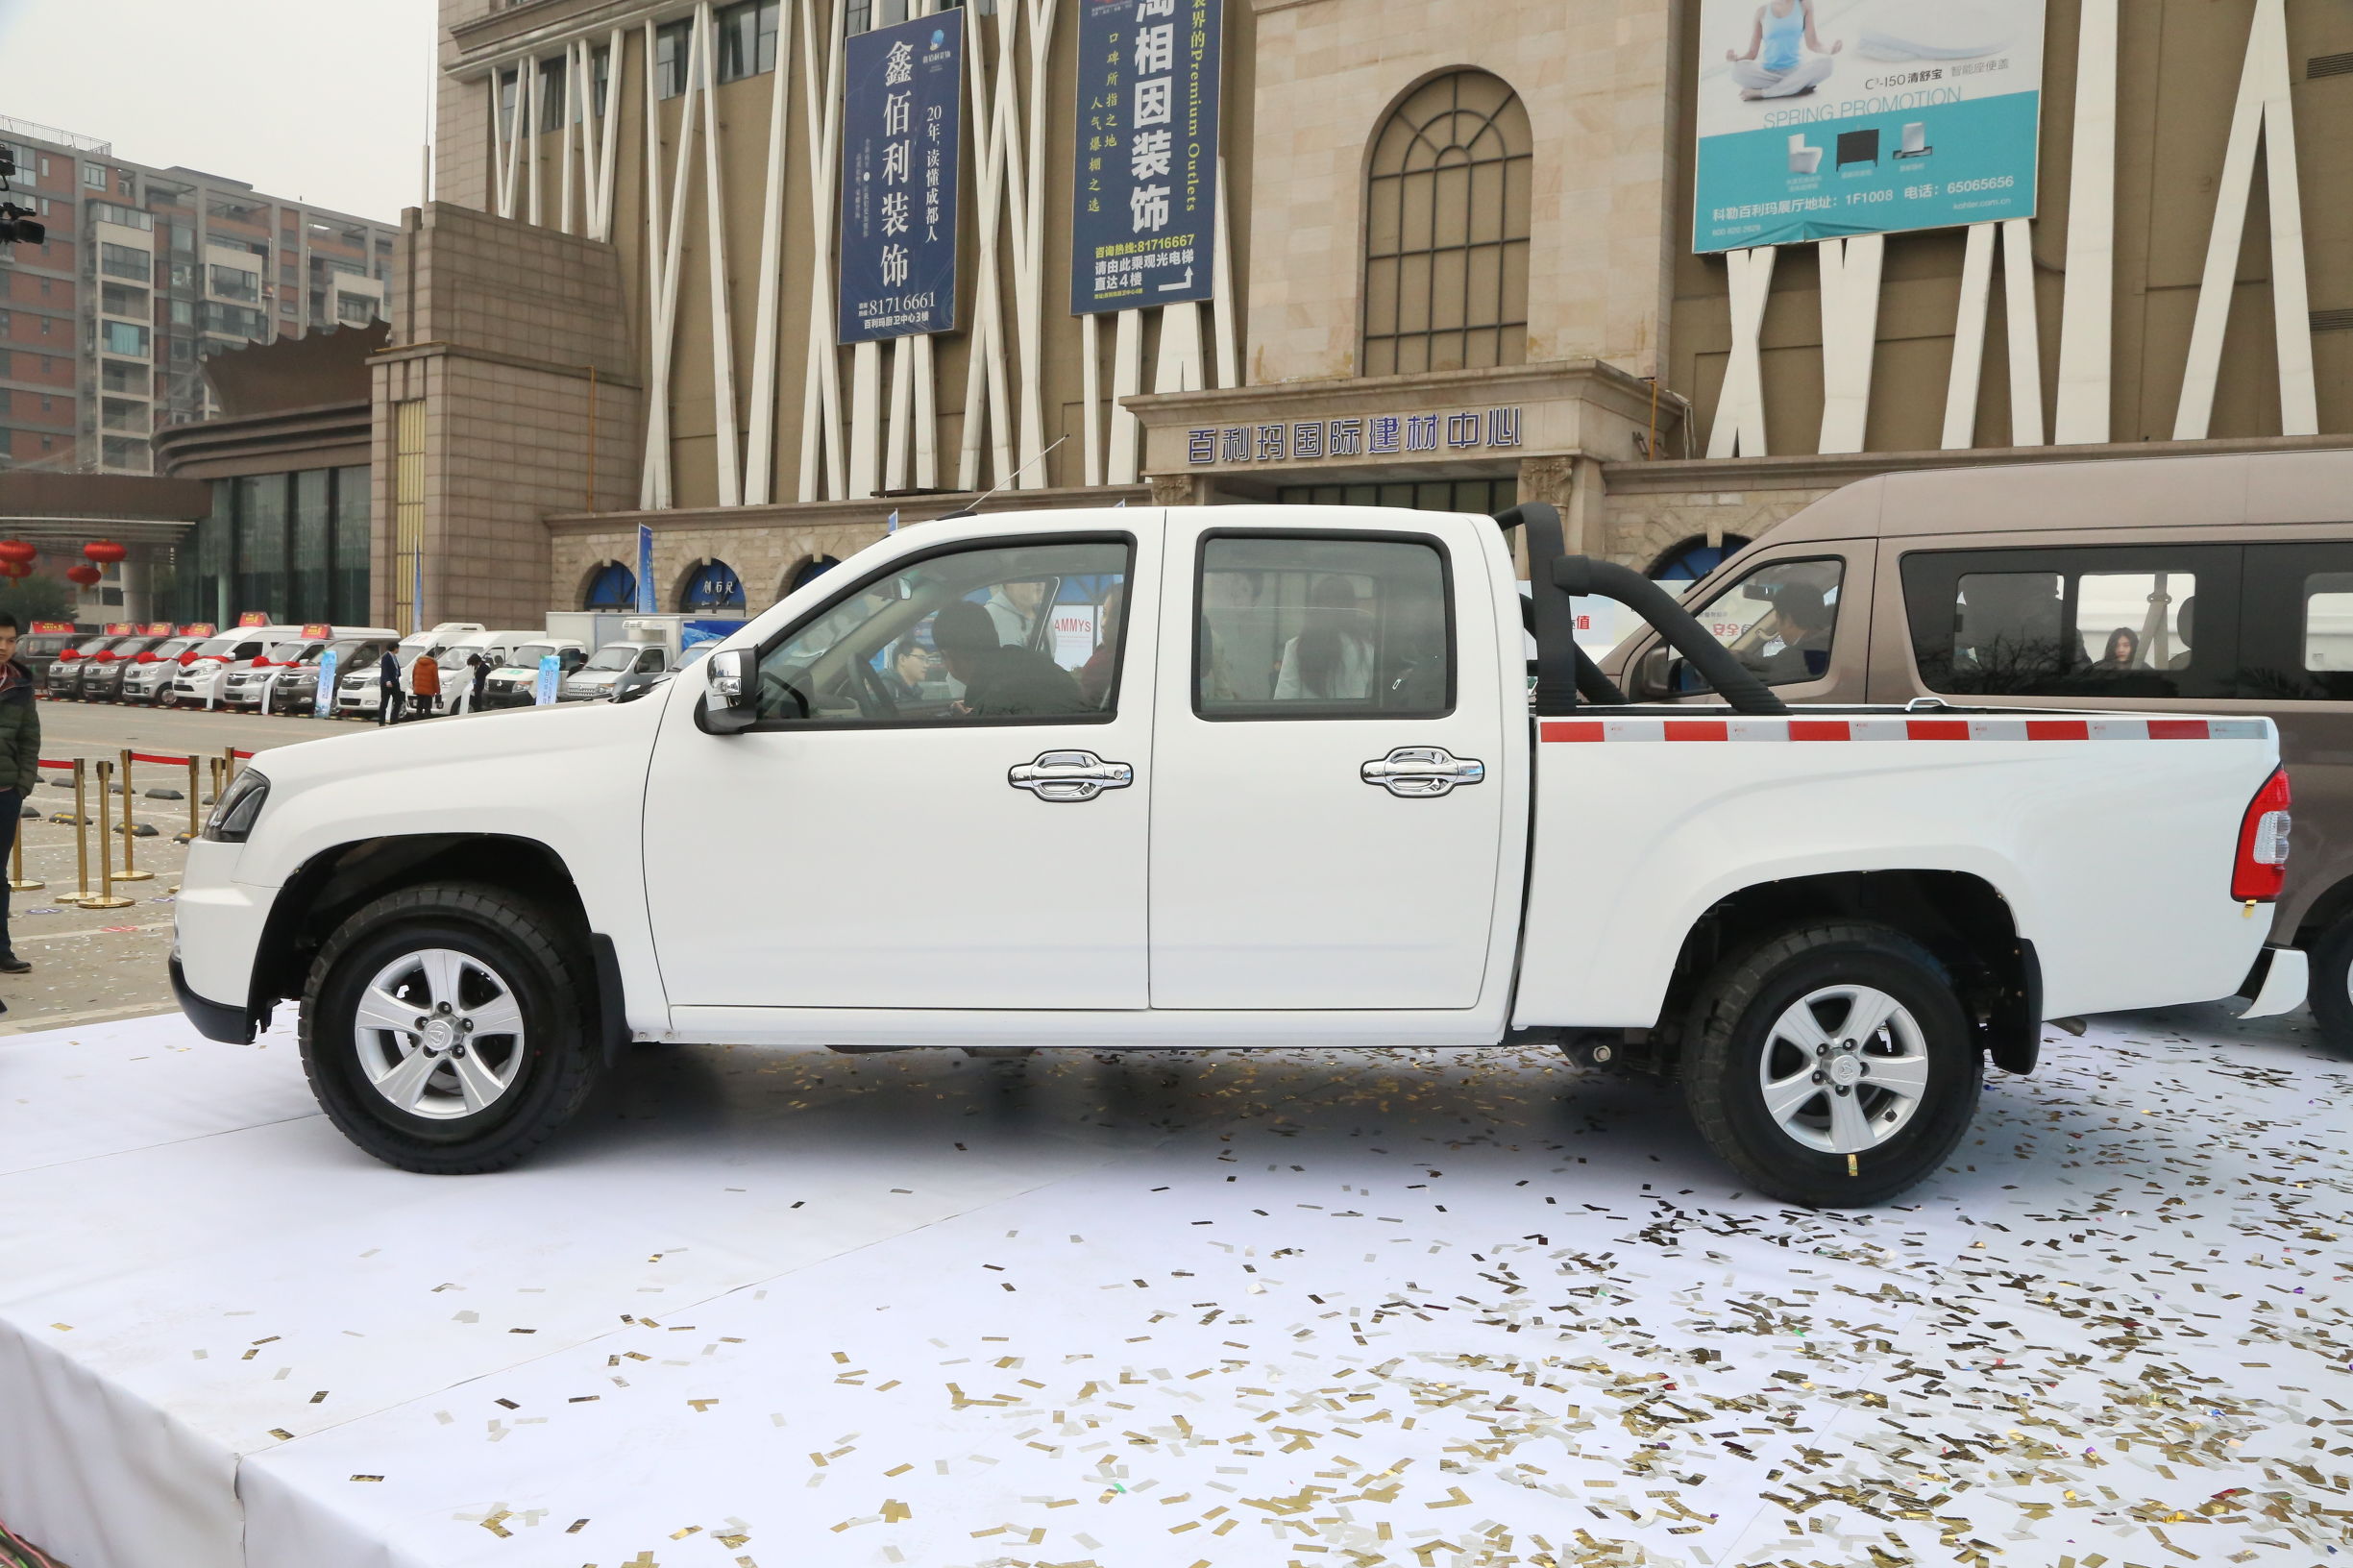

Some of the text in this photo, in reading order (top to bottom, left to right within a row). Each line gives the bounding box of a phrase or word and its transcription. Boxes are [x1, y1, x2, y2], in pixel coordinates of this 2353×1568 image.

[1105, 33, 1119, 147] 口碑所指之地
[1763, 86, 1962, 129] SPRING PROMOTION
[880, 40, 914, 287] 鑫佰利装饰
[1087, 96, 1103, 212] 人气爆棚之选
[1187, 143, 1200, 211] Outlets
[1846, 189, 1894, 206] 1F1008
[1947, 175, 2014, 195] 65065656
[1094, 249, 1194, 276] 请由此乘观光电梯
[1094, 271, 1142, 291] 直达4楼
[1188, 406, 1522, 465] 百利玛国际建材中心
